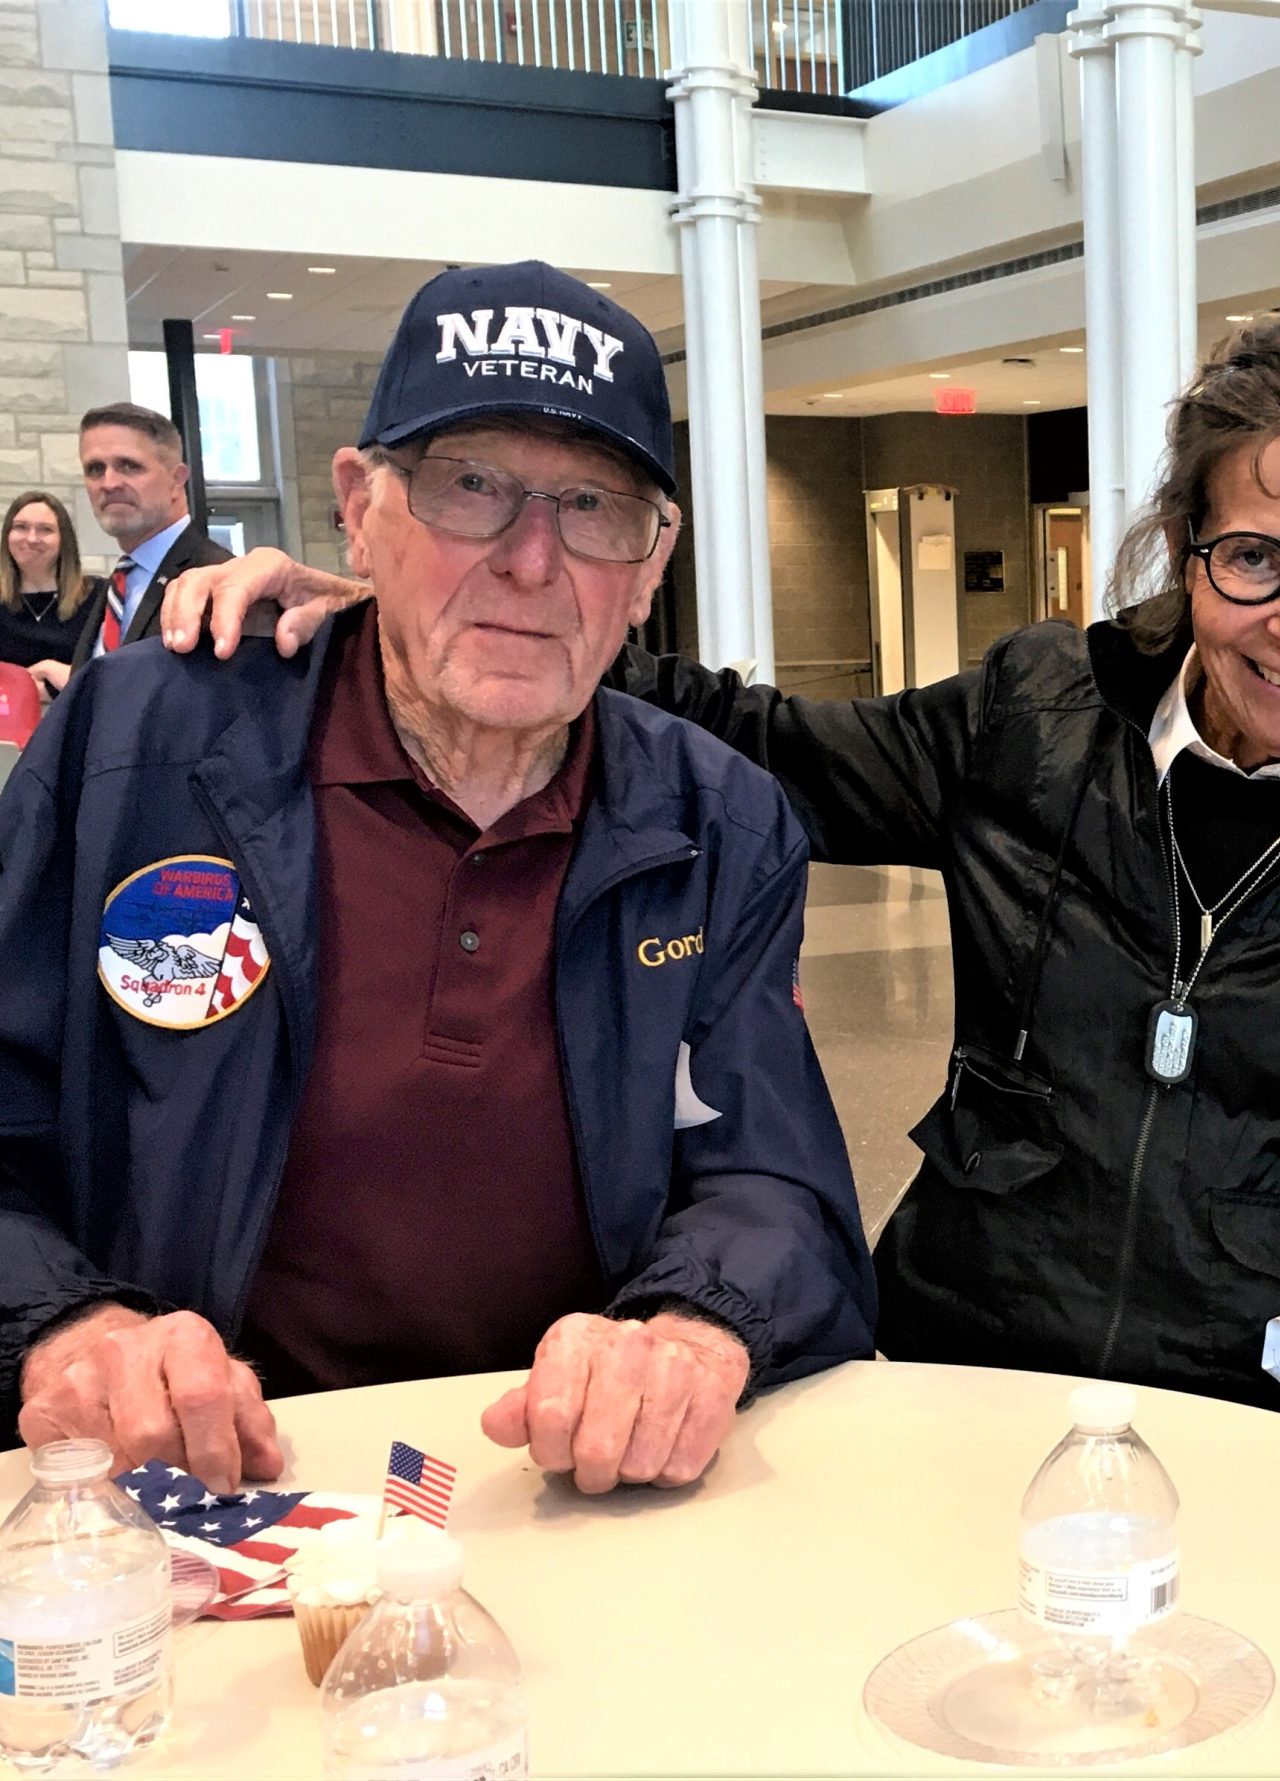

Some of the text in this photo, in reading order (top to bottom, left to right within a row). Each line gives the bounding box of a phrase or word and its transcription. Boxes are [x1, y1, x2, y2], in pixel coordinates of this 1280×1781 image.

[436, 306, 624, 383] NAVY
[462, 359, 594, 395] VETERAN
[161, 869, 232, 887] WARBIRDS
[152, 881, 234, 902] OF AMERICA
[120, 974, 206, 996] Squadron 4
